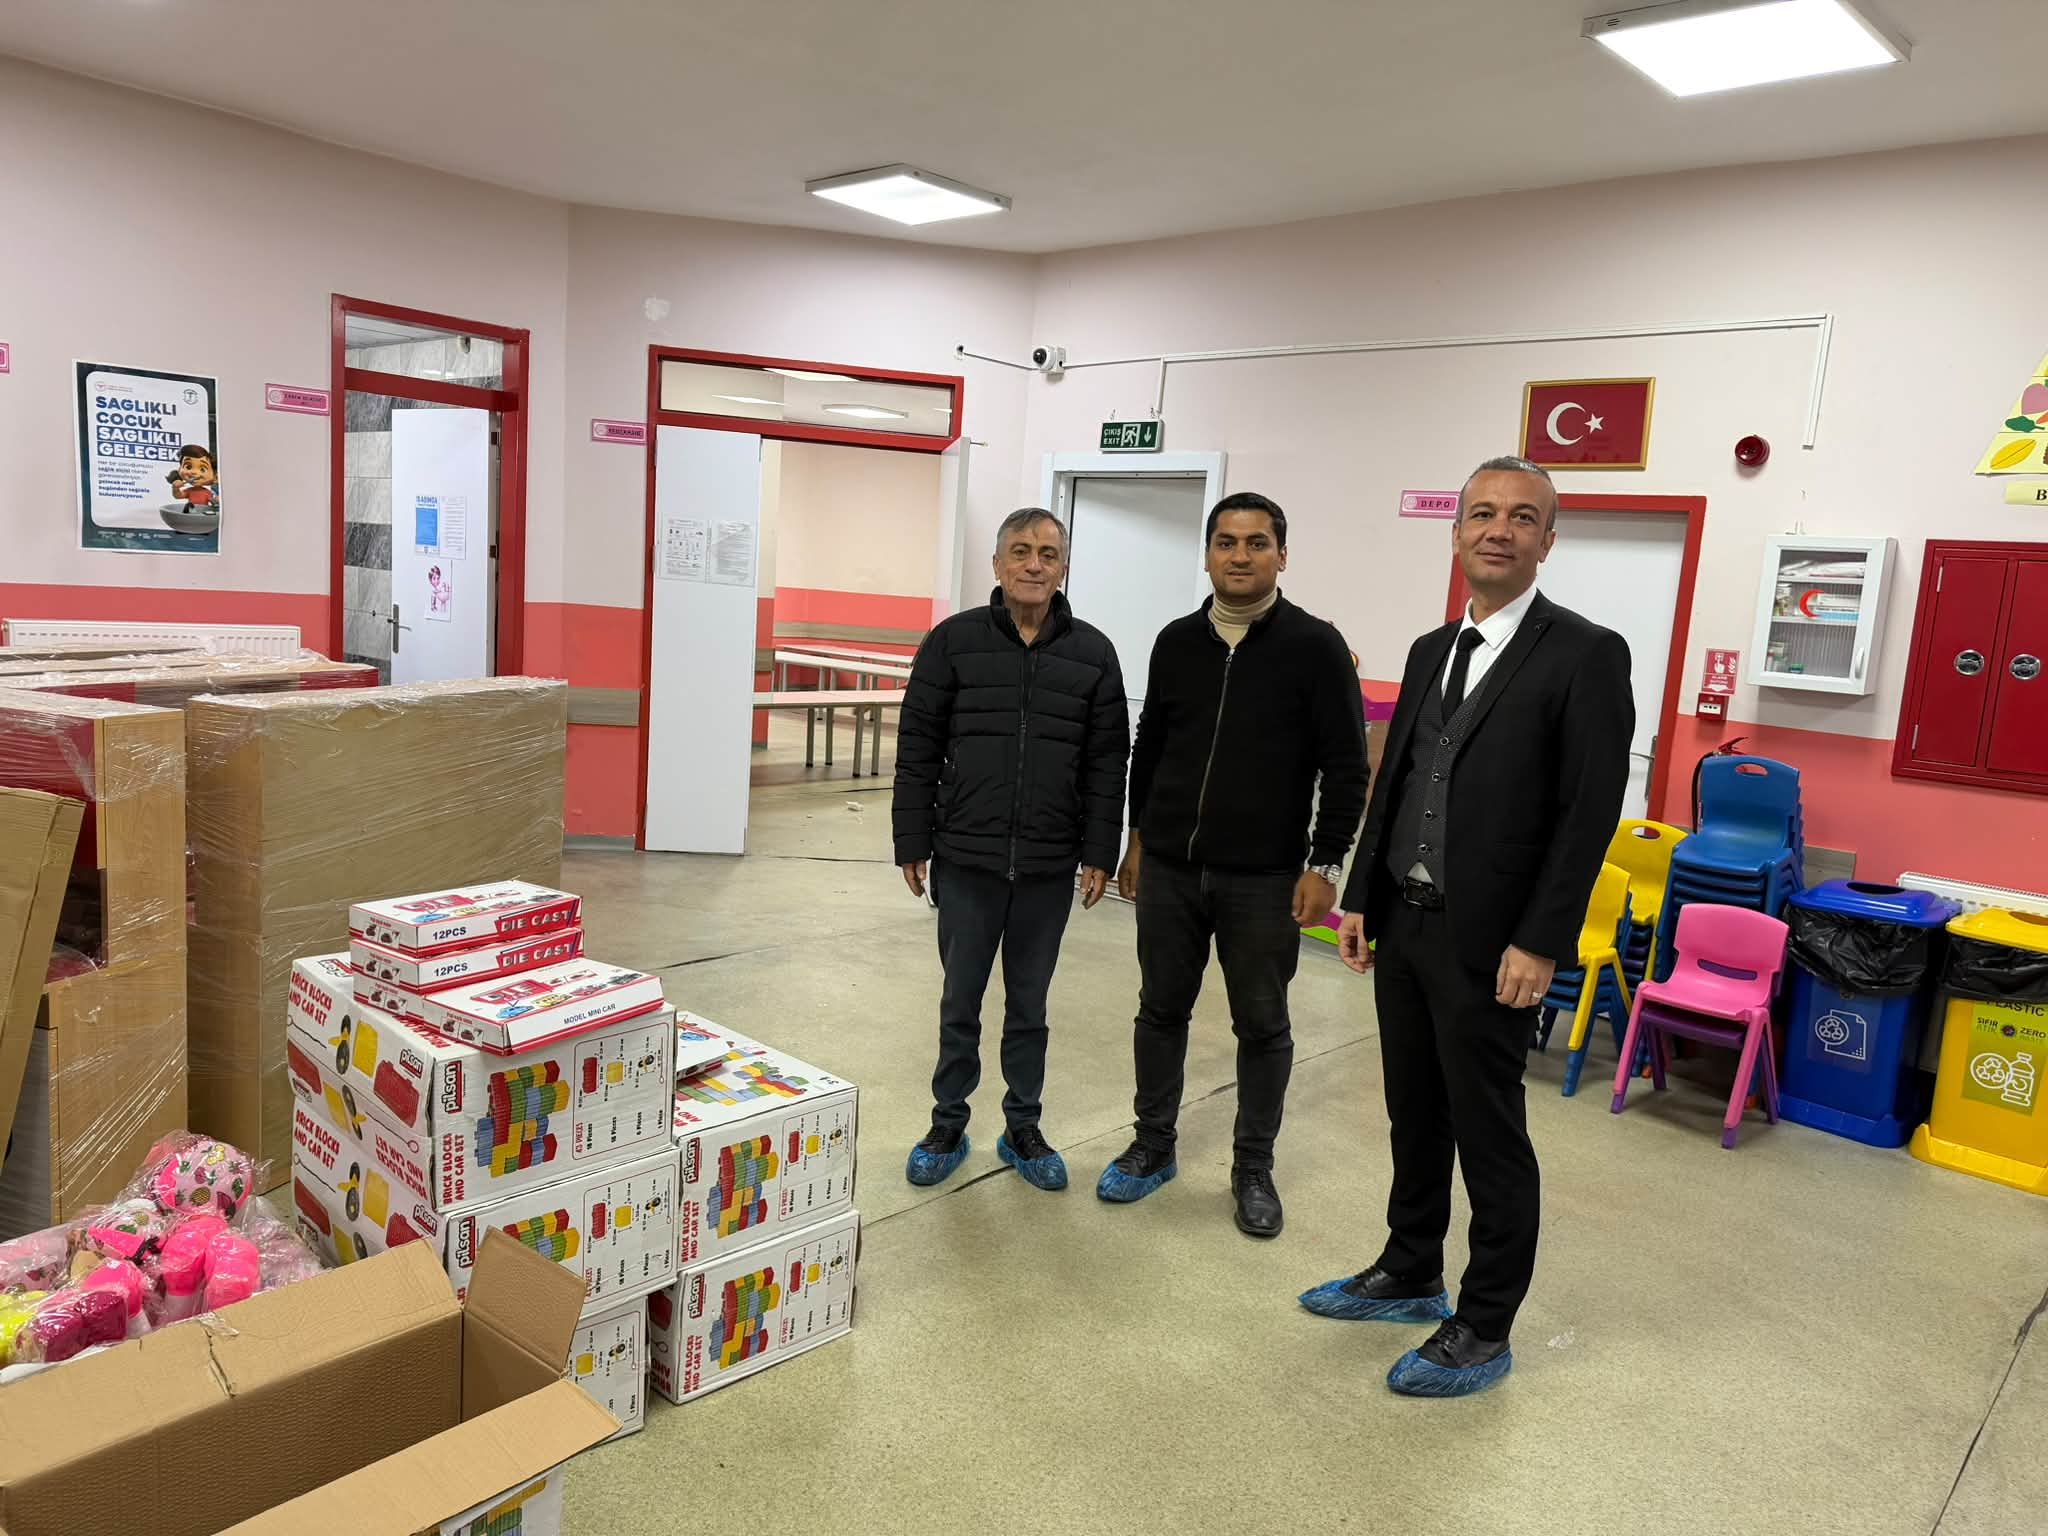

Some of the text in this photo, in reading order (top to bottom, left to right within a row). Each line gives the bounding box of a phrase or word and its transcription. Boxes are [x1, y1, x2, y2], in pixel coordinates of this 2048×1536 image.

[99, 442, 181, 461] GELECEK
[1420, 500, 1450, 508] DEPO
[432, 926, 467, 941] 12PCS
[500, 910, 571, 932] DIE CAST
[433, 962, 468, 977] 12PCS
[502, 944, 573, 967] DIE CAST
[291, 971, 333, 1011] BRICK BLOCKS
[301, 999, 314, 1018] CAR
[314, 1009, 328, 1028] SET
[563, 1003, 617, 1026] MODEL MINI CAR
[1977, 1017, 2047, 1039] SIFIR ZERO
[400, 1048, 424, 1076] pilsan
[442, 1061, 460, 1113] pilsan
[296, 1110, 341, 1156] BRICK BLOCKS
[294, 1128, 335, 1170] AND CAR SET
[684, 1141, 698, 1183] pilsan
[443, 1133, 453, 1204] BRICK BLOCKS
[455, 1134, 464, 1200] AND CAR SET
[413, 1204, 437, 1233] pilsan
[691, 1201, 699, 1218] SET
[456, 1219, 473, 1268] pilsan
[682, 1200, 691, 1263] BRICK BLOCKS
[690, 1240, 698, 1259] AND
[688, 1275, 701, 1319] pilsan
[694, 1335, 703, 1351] SET
[684, 1335, 694, 1394] BRICK BLOCKS
[692, 1372, 700, 1391] AND
